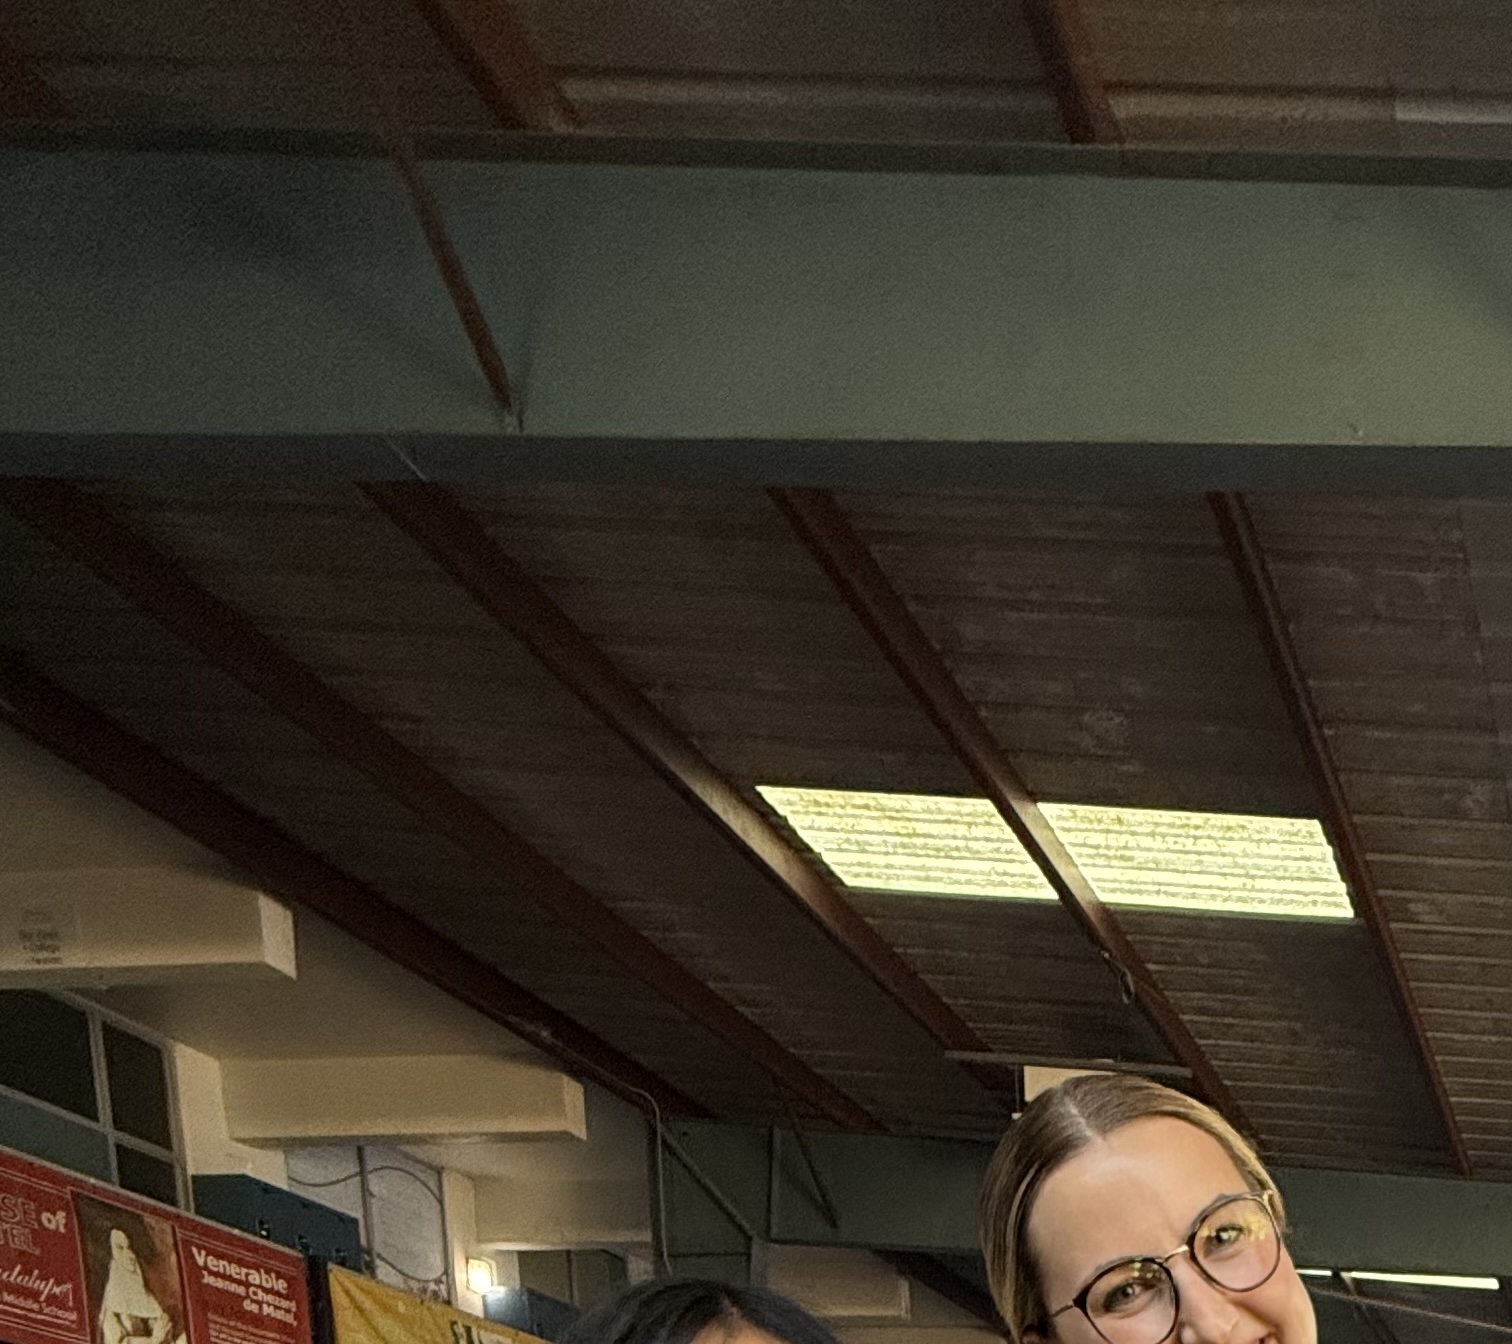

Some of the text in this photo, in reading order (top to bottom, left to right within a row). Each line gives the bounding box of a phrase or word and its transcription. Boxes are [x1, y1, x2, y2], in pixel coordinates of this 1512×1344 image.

[41, 1210, 67, 1233] of
[191, 1246, 288, 1294] Venerable
[201, 1270, 247, 1296] Jeanne
[243, 1299, 259, 1314] de
